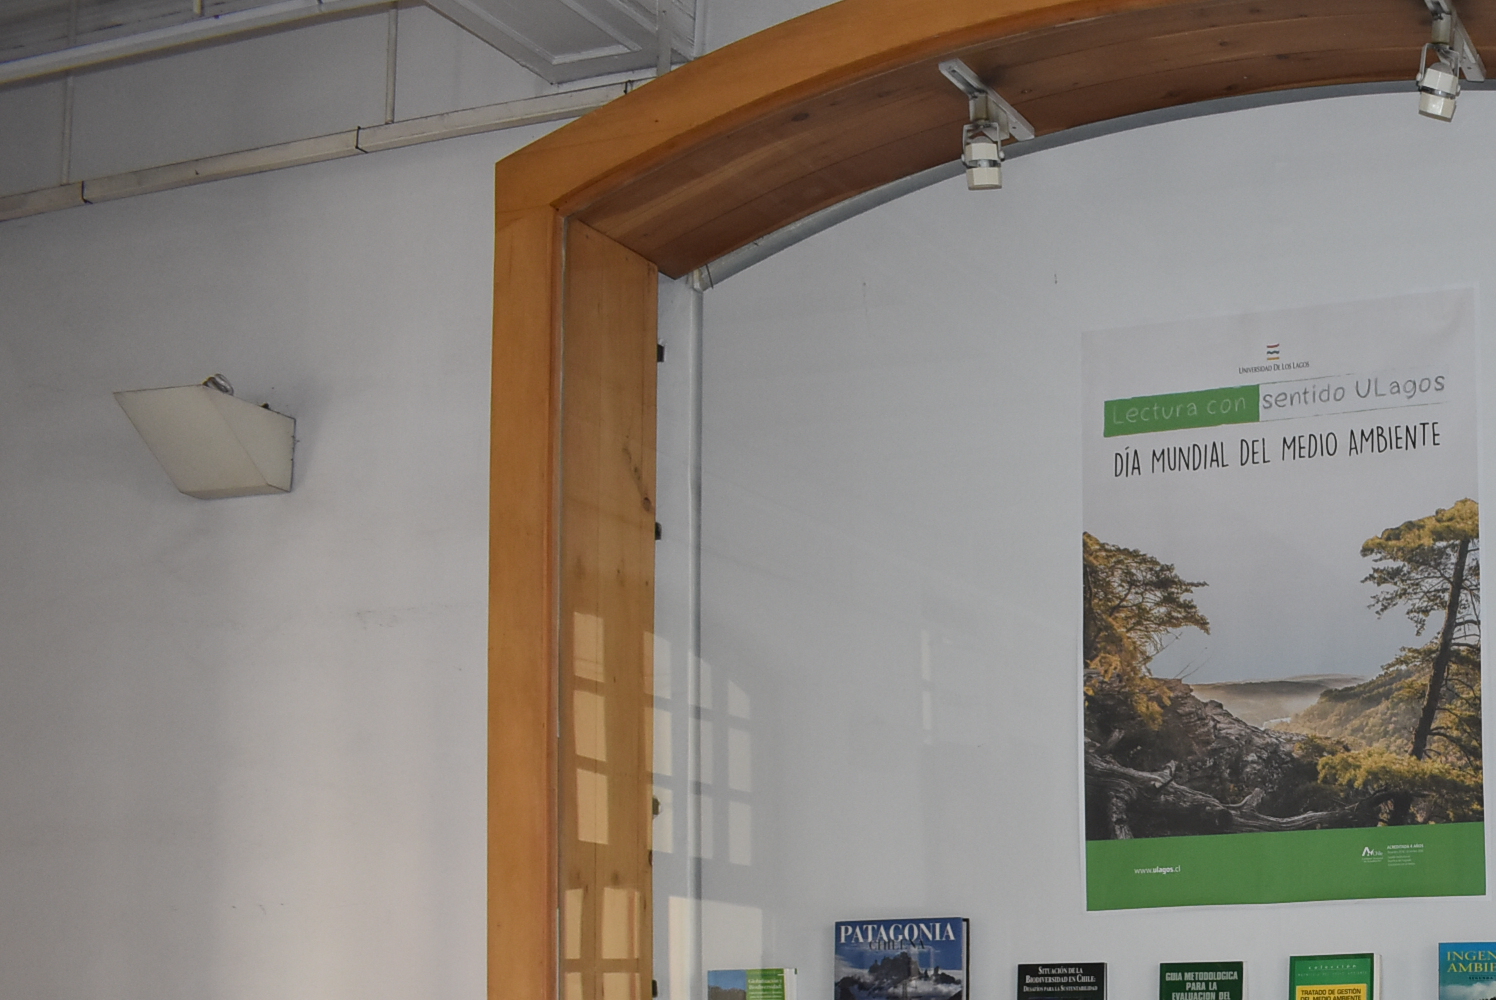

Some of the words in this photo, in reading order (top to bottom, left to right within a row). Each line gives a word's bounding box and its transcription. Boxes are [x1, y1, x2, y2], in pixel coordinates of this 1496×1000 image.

[1112, 402, 1198, 426] Lectura
[1207, 395, 1247, 415] con
[1261, 384, 1346, 410] sentido
[1354, 373, 1446, 400] ULagos
[1113, 446, 1142, 478] DÍA
[1151, 441, 1229, 474] MUNDIAL
[1239, 438, 1271, 467] DEL
[1281, 430, 1338, 462] MEDIO
[1348, 421, 1441, 457] AMBIENTE
[839, 922, 956, 944] PATAGONIA
[1165, 972, 1183, 981] GUIA
[1184, 971, 1239, 981] METODOLOGICA
[1185, 981, 1206, 991] PARA
[1208, 981, 1218, 991] LA
[1336, 987, 1362, 995] GESTIÓN
[1171, 991, 1216, 1000] EVALUACION
[1218, 991, 1231, 1000] DEL
